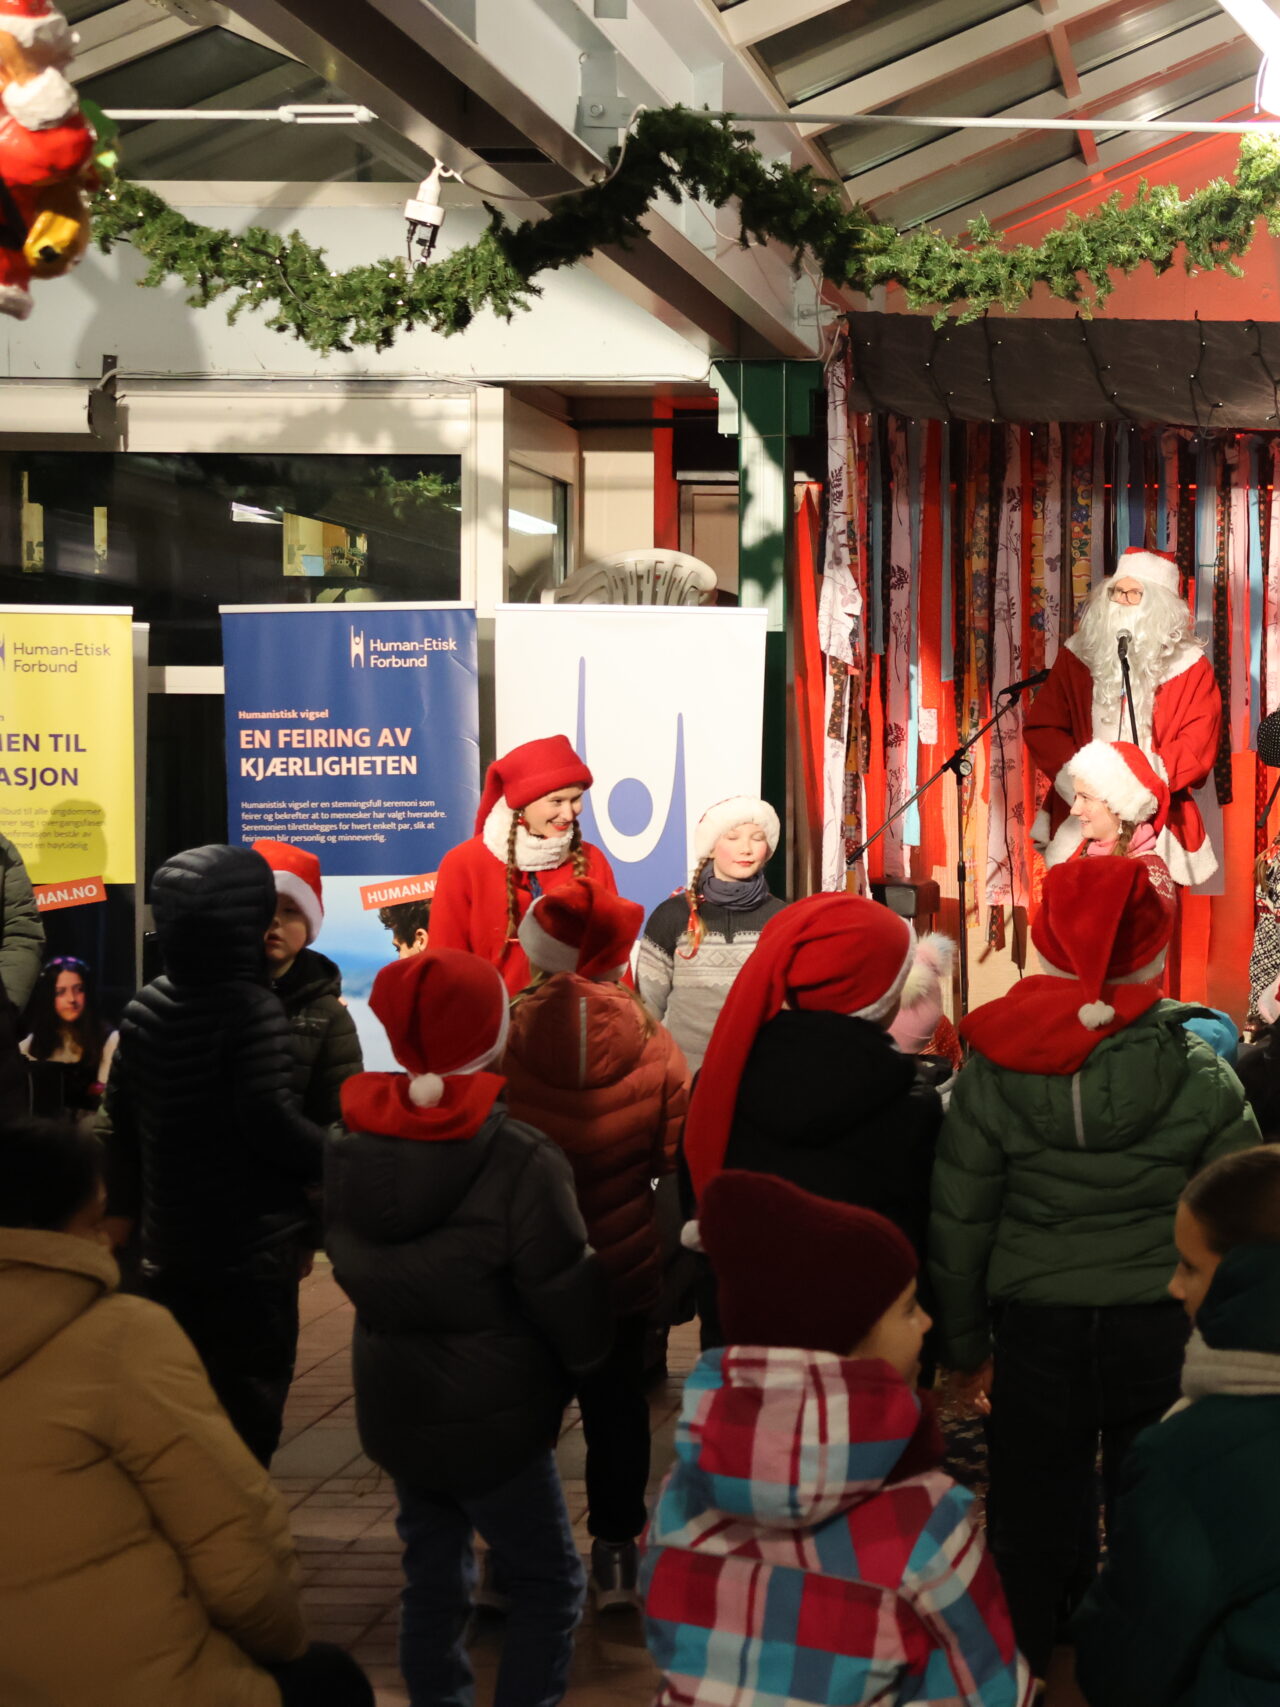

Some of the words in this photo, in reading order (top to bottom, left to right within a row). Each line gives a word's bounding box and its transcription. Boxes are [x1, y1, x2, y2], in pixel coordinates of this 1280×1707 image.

[13, 642, 112, 656] Human-Etisk
[370, 638, 458, 652] Human-Etisk
[14, 660, 79, 673] Forbund
[370, 654, 428, 668] Forbund
[238, 709, 299, 720] Humanistisk
[300, 708, 329, 721] vigsel
[0, 733, 40, 753] EN
[48, 733, 87, 753] TIL
[240, 729, 271, 749] EN
[278, 728, 371, 749] FEIRING
[377, 727, 412, 747] AV
[241, 755, 418, 782] KJÆRLIGHETEN
[241, 801, 287, 810] Humanistisk
[288, 801, 310, 811] vigsel
[331, 800, 382, 810] stemningsfull
[383, 799, 418, 808] seremoni
[241, 812, 262, 820] feirer
[263, 814, 274, 822] og
[275, 812, 310, 820] bekrefter
[330, 811, 371, 819] mennesker
[387, 811, 406, 820] valgt
[407, 810, 447, 818] hverandre.
[242, 823, 287, 832] Seremonien
[287, 822, 338, 833] tilrettelegges
[339, 822, 350, 830] for
[351, 822, 371, 830] hvert
[373, 821, 397, 830] enkelt
[398, 823, 413, 832] par,
[413, 821, 426, 829] slik
[277, 833, 289, 842] blir
[291, 833, 326, 844] personlig
[327, 835, 337, 844] og
[338, 832, 387, 844] minneverdig.
[36, 884, 98, 906] MAN.NO
[367, 879, 437, 904] HUMAN.N
